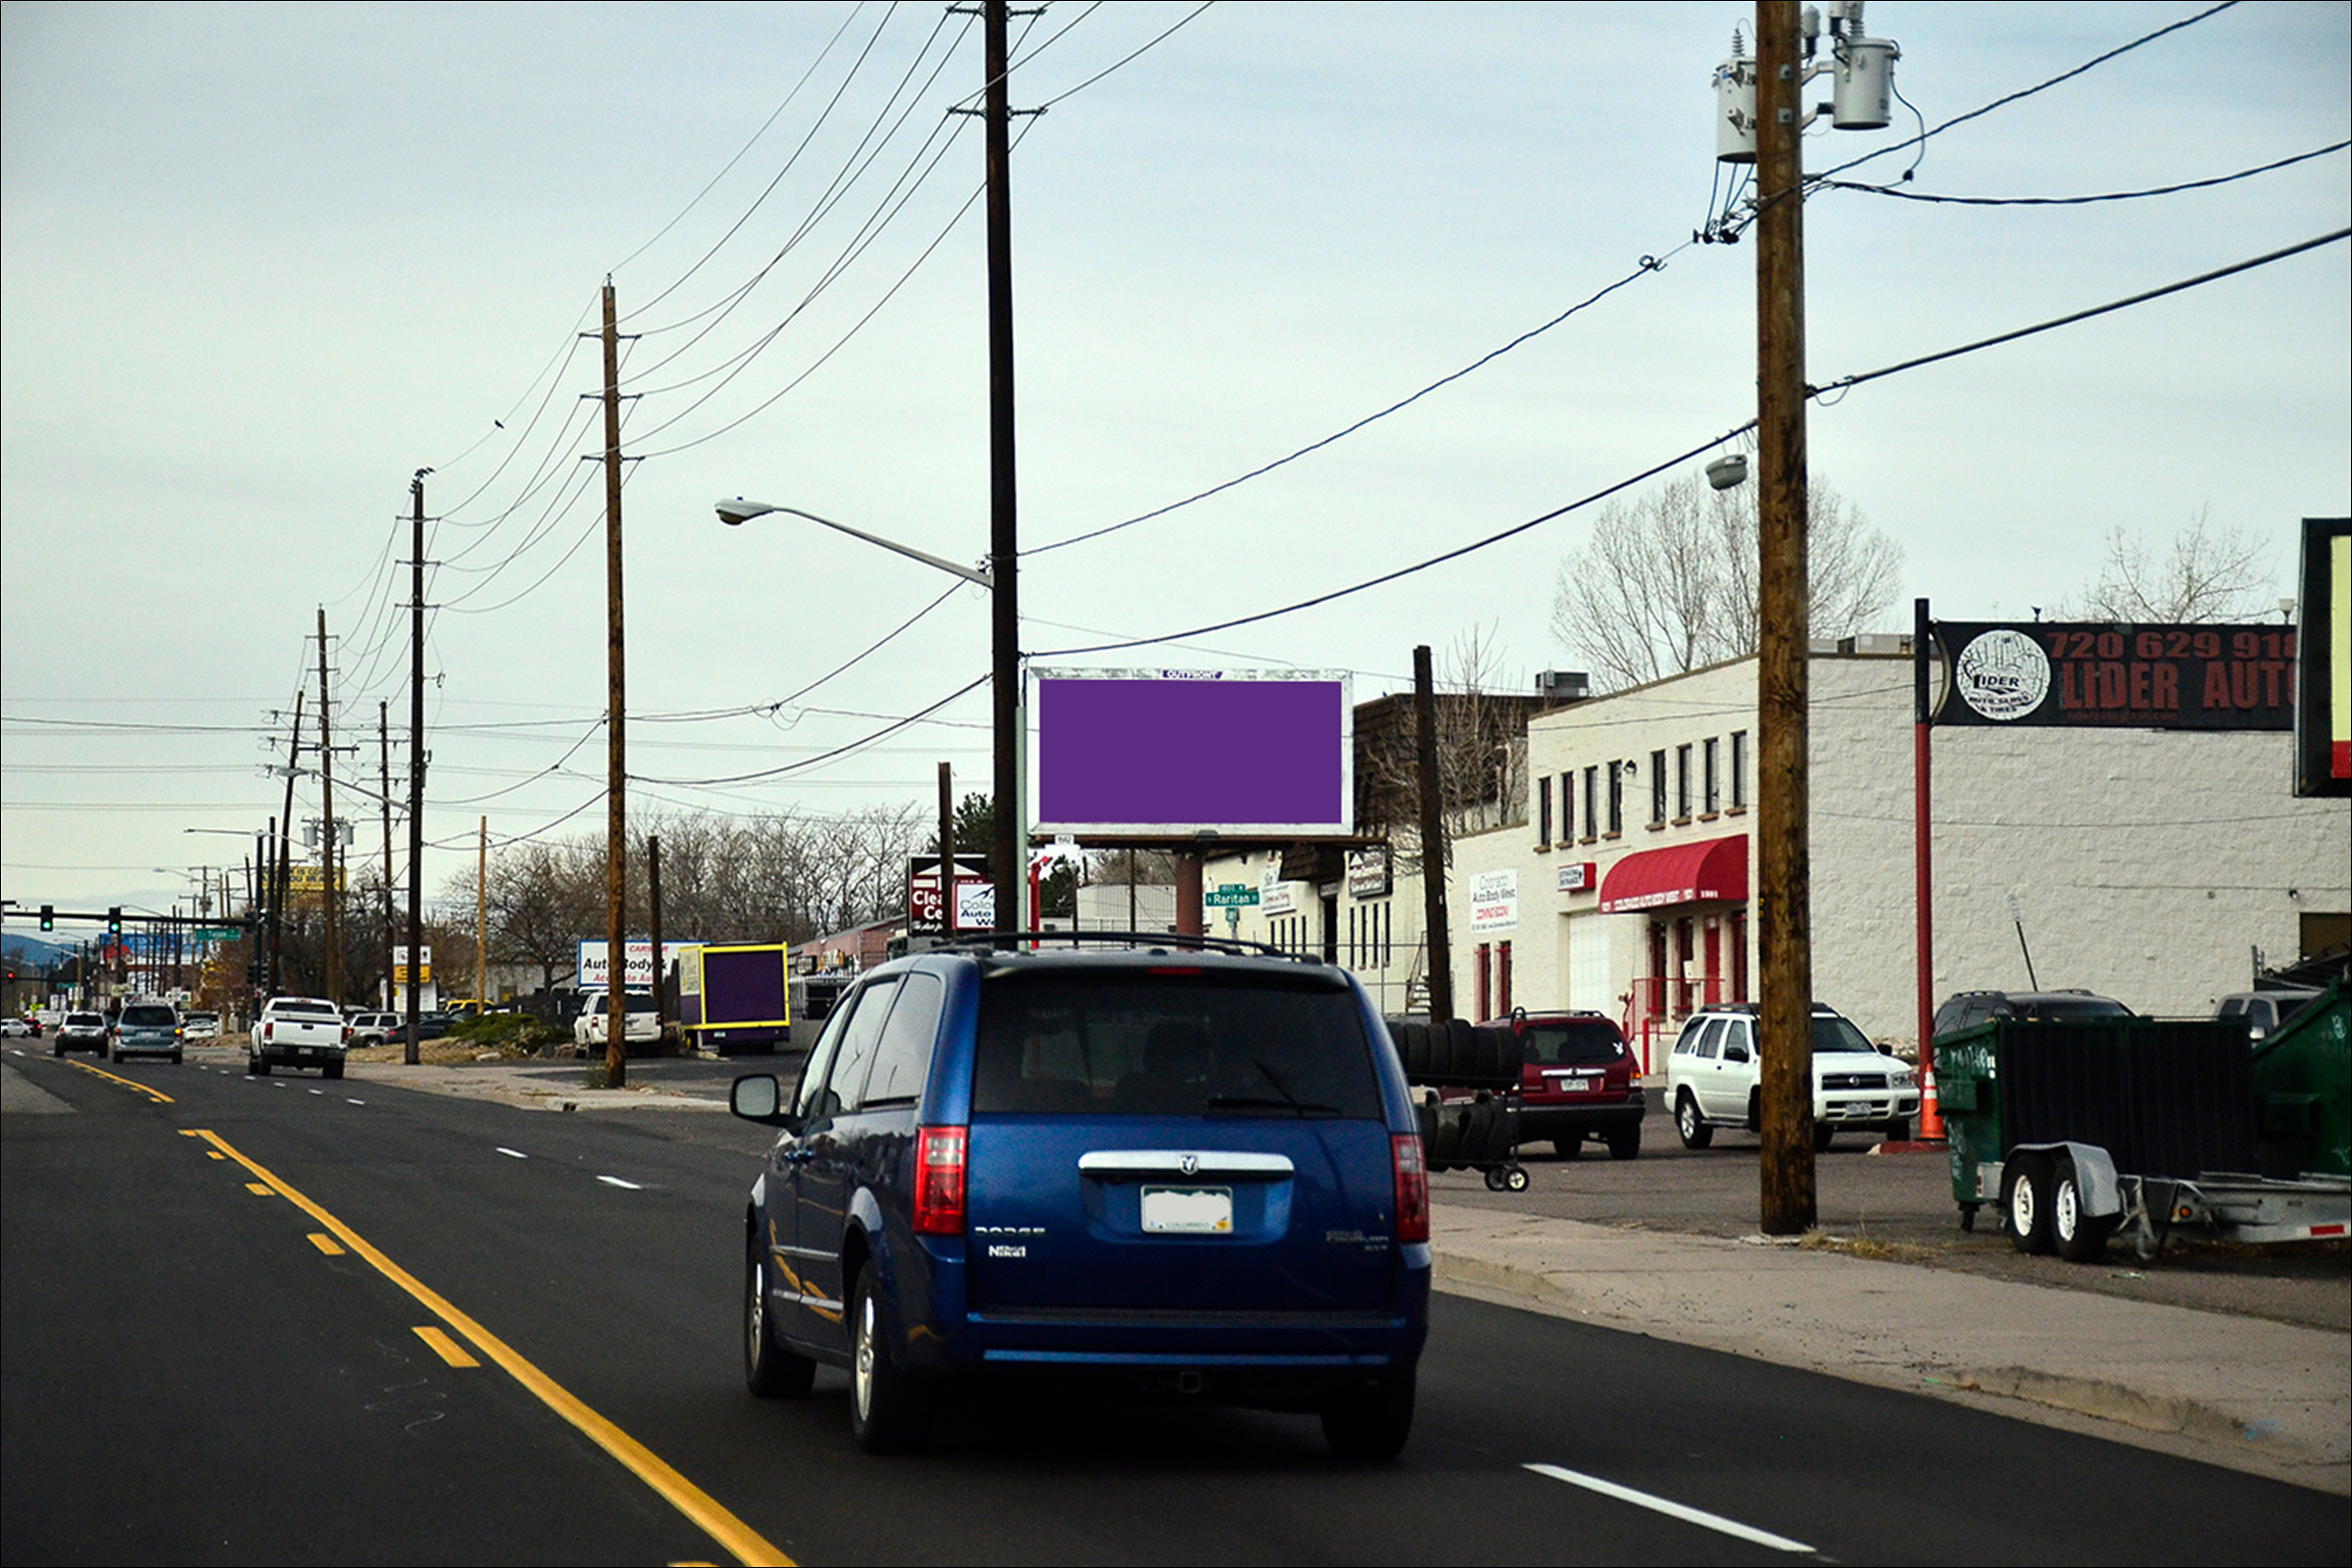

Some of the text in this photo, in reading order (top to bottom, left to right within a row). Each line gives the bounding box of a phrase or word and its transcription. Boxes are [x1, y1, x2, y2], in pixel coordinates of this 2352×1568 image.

[2047, 631, 2124, 660] 720
[2136, 631, 2222, 660] 629
[2062, 661, 2295, 710] LIDER AUT
[1214, 894, 1250, 906] Raritan
[628, 945, 669, 954] CARSR
[583, 957, 610, 970] Aut
[974, 1225, 1047, 1238] DODGE
